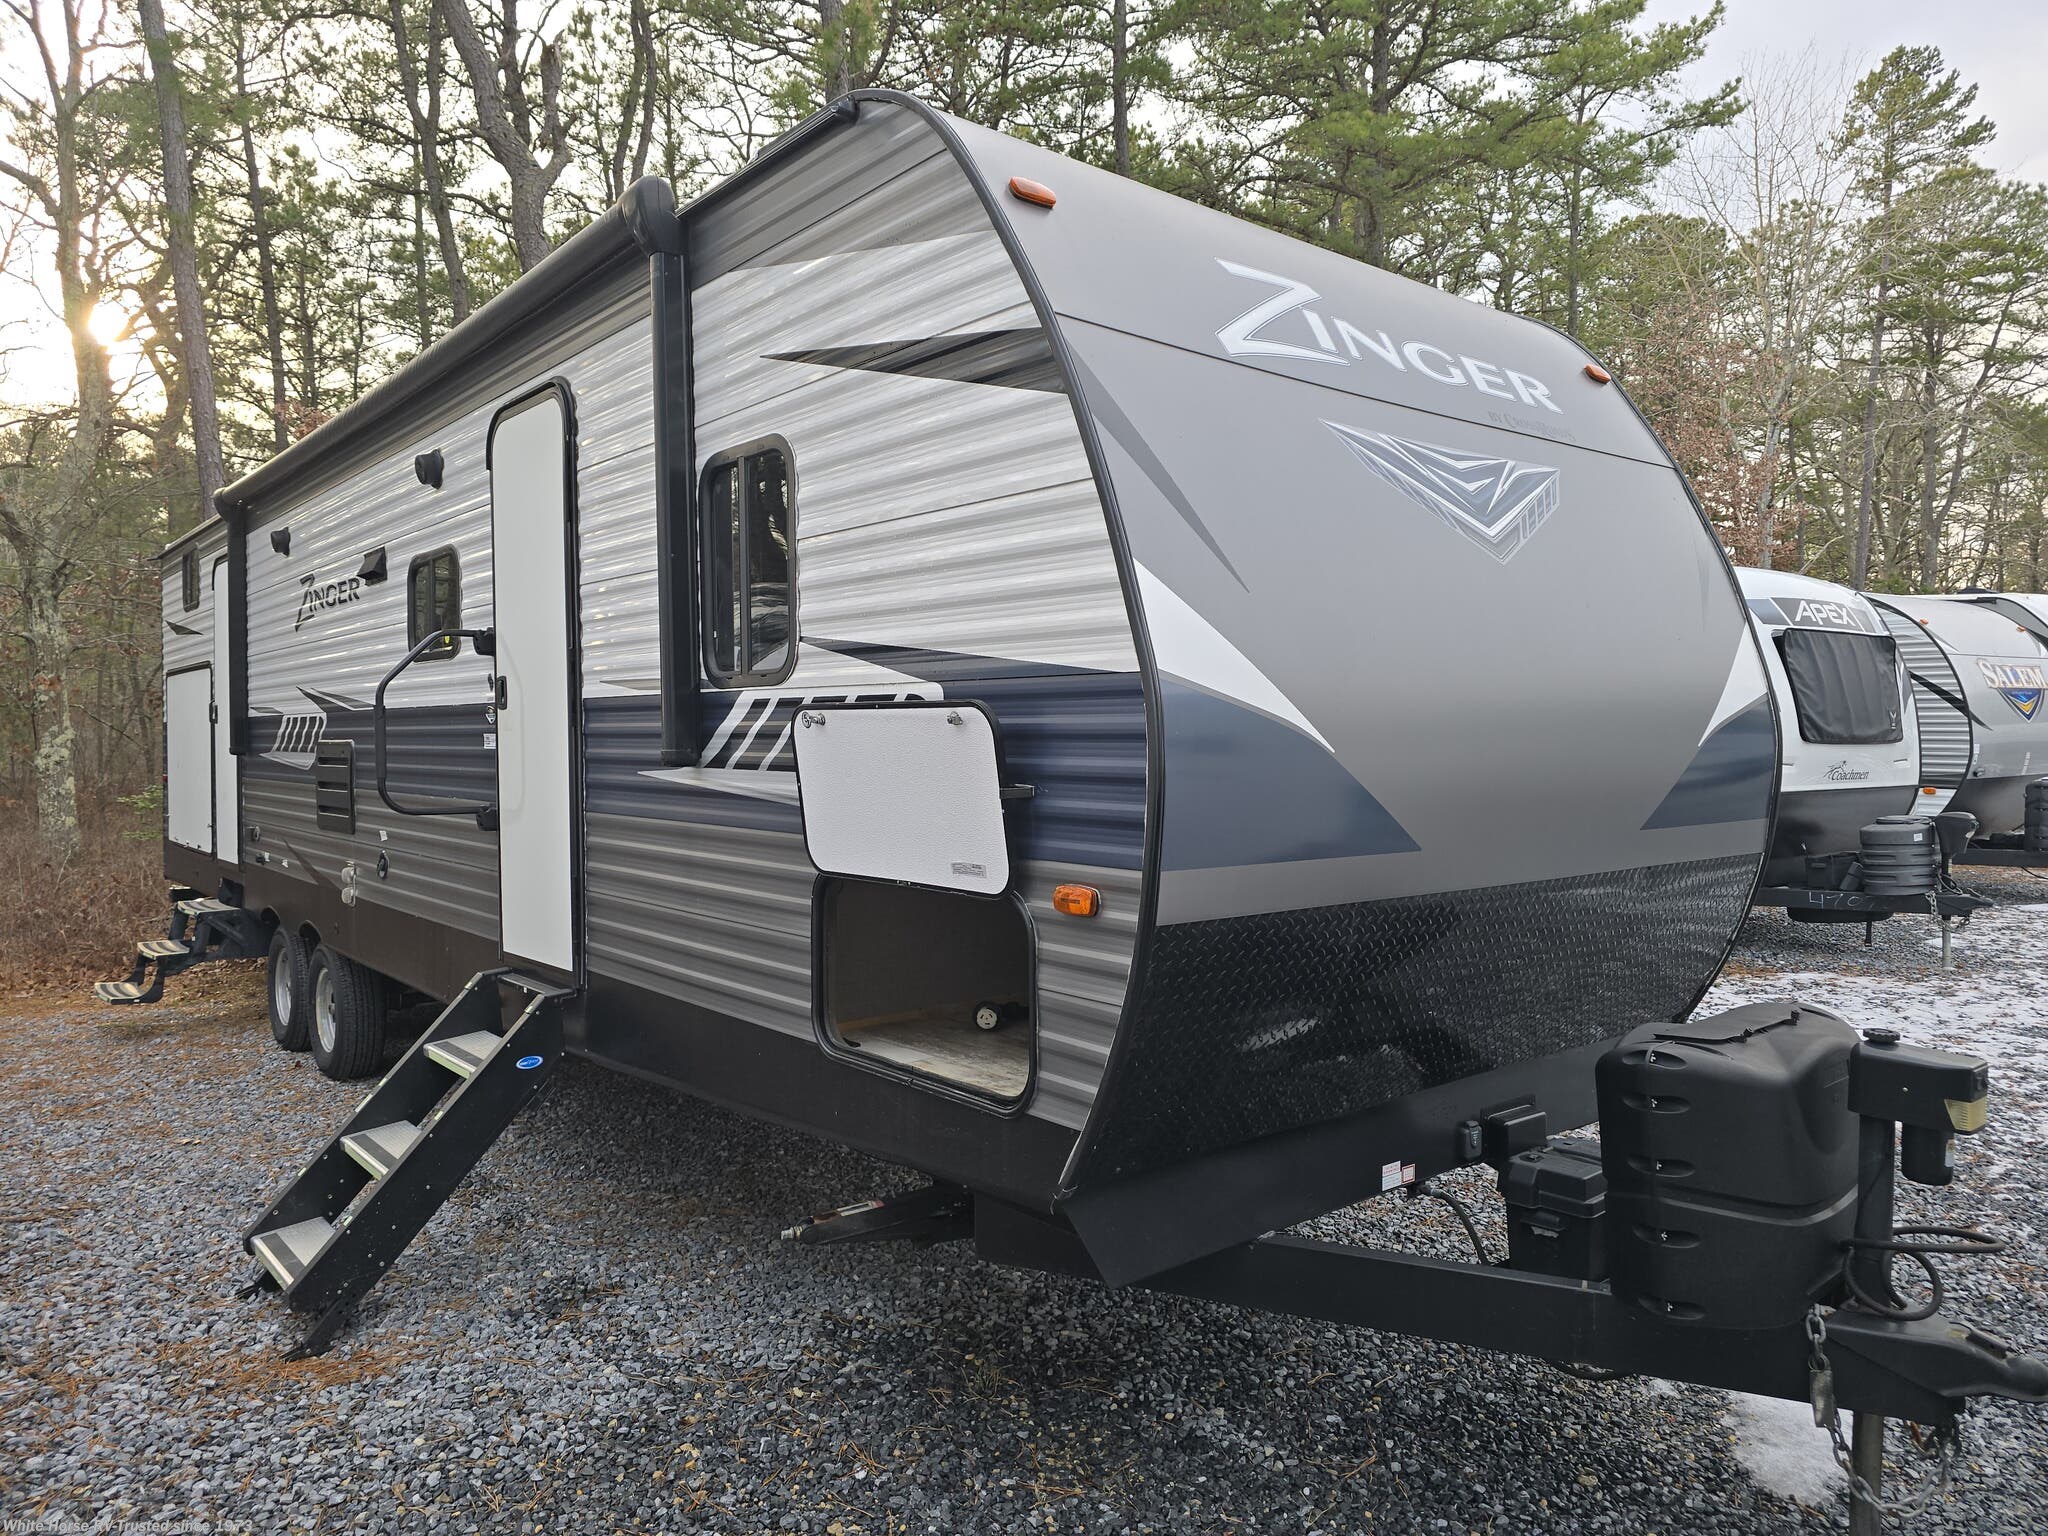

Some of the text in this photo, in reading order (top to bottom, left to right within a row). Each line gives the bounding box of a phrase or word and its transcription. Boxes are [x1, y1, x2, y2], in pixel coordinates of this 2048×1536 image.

[1214, 256, 1564, 415] ZINGER
[294, 573, 360, 632] ZINGER
[1794, 600, 1856, 627] APEX
[1976, 657, 2048, 689] SALEM
